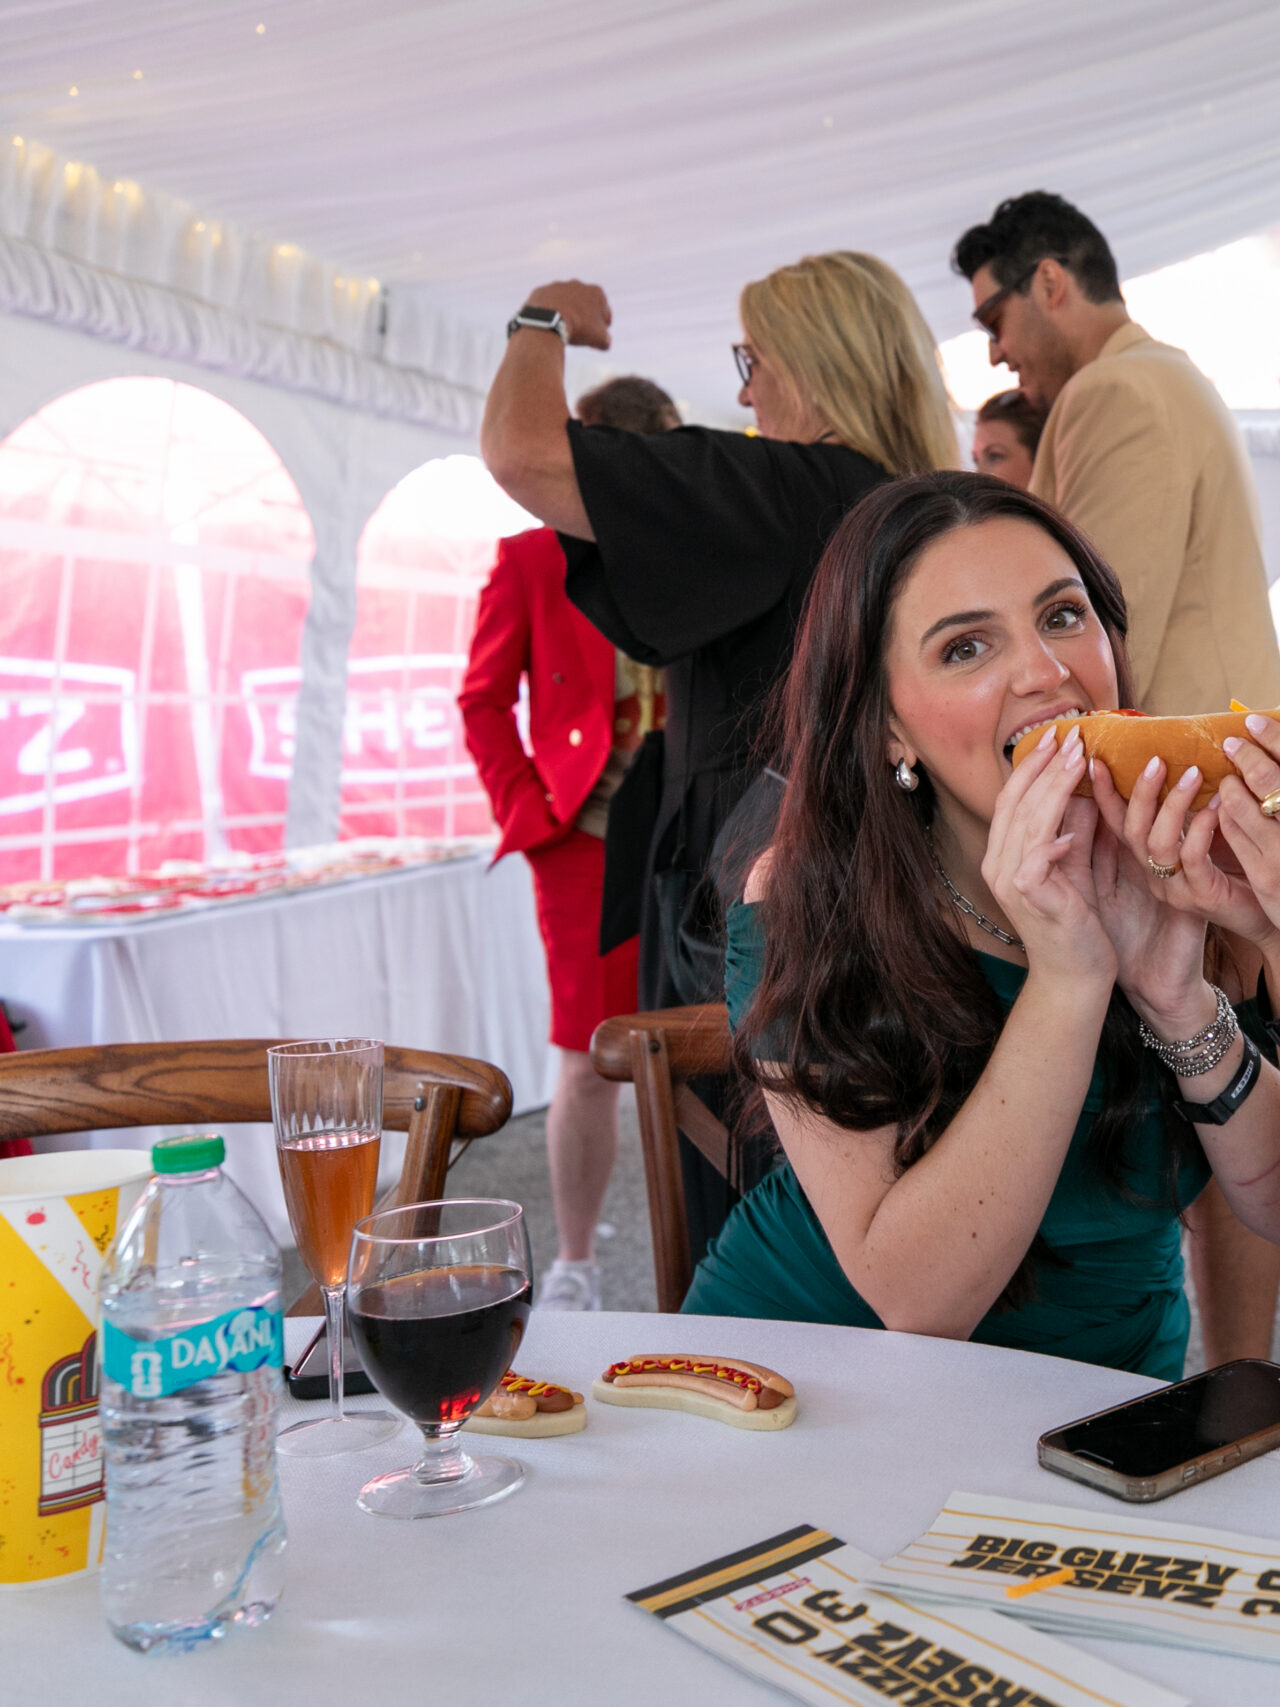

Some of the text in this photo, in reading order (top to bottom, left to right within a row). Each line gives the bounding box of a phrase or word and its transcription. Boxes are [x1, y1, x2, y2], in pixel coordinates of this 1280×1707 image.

[170, 1317, 272, 1372] DASANI
[966, 1534, 1239, 1588] BIG GLIZZY
[752, 1589, 869, 1645] 30
